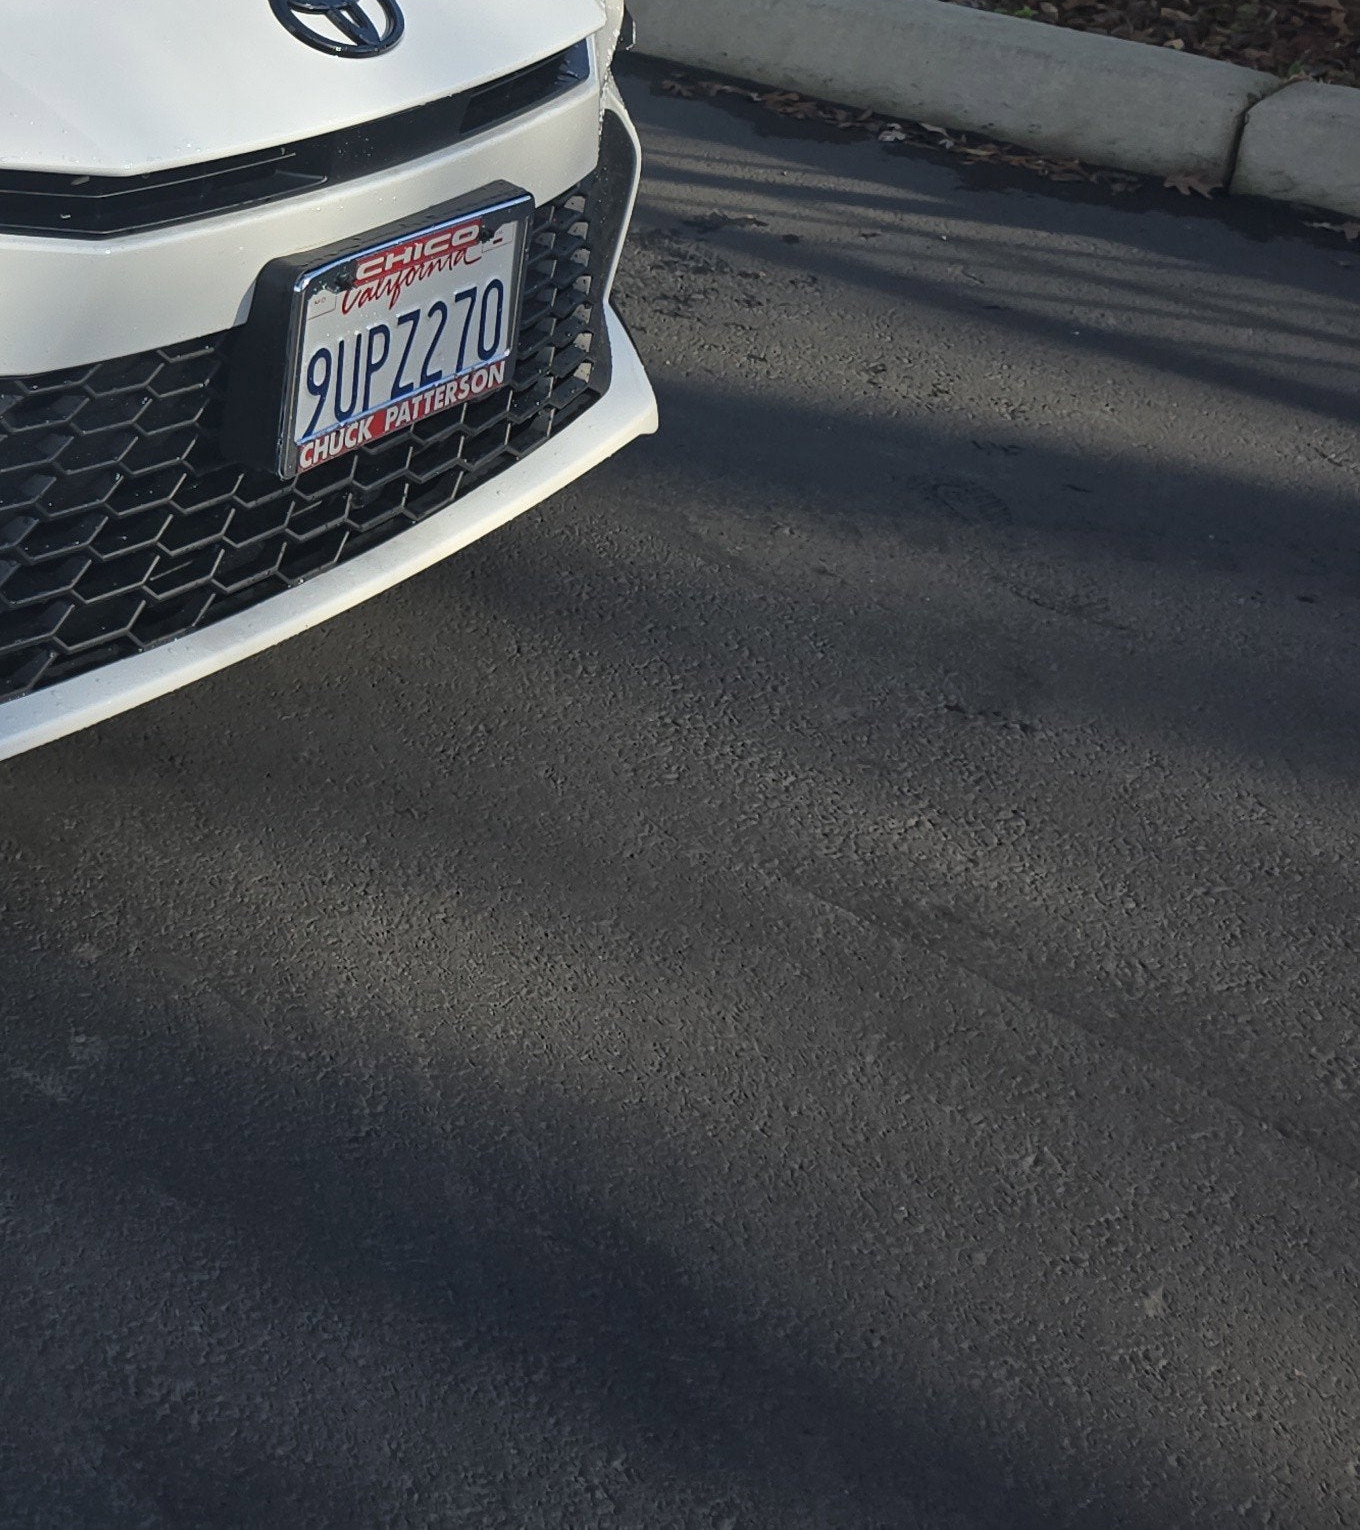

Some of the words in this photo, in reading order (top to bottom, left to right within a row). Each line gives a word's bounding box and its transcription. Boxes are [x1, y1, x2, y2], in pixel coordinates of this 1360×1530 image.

[356, 225, 479, 279] CHICO
[302, 278, 504, 439] 9UPZ270
[299, 415, 374, 469] CHUCK
[384, 362, 505, 432] PATTERSON
